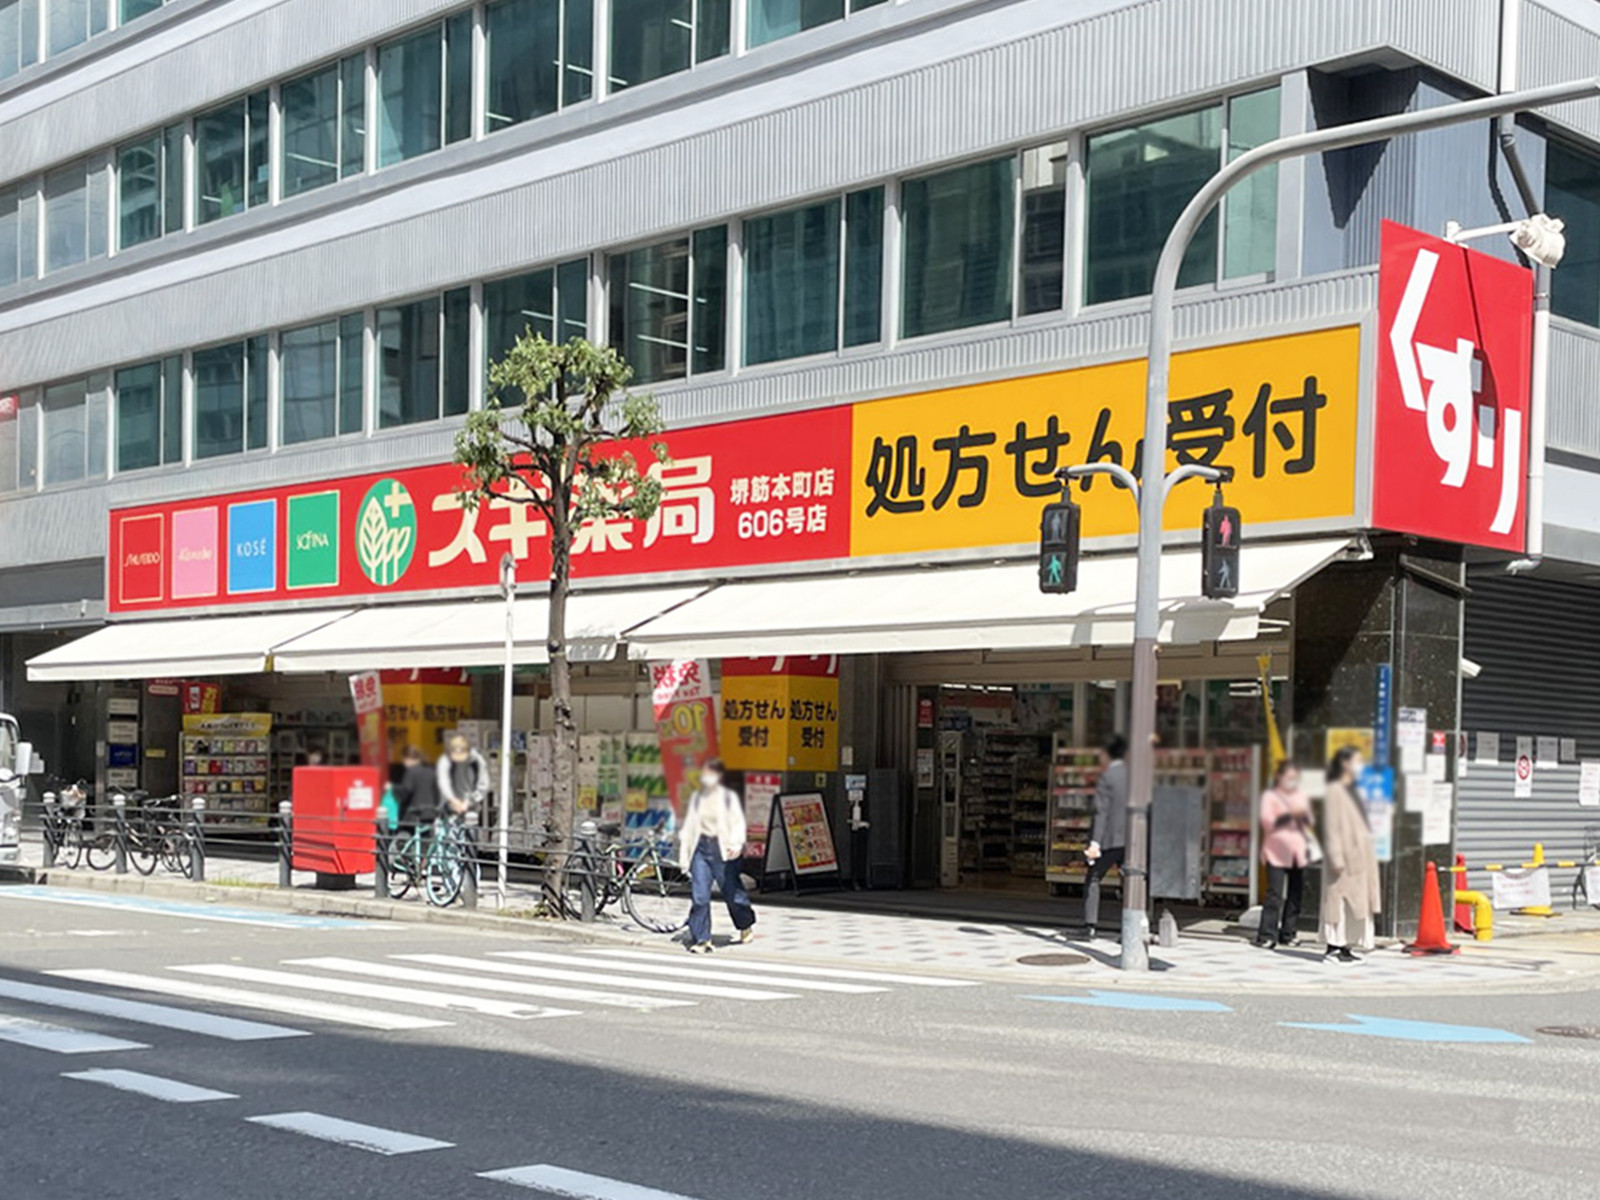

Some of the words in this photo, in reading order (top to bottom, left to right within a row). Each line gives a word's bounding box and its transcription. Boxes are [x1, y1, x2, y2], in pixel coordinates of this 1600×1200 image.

[1390, 248, 1522, 534] くすり
[865, 375, 1327, 518] 処方せん受付
[730, 467, 834, 506] 堺筋本町店
[738, 504, 827, 539] 606号店
[724, 699, 785, 720] 処方せん
[790, 699, 837, 721] 処方せん
[739, 726, 769, 747] 受付
